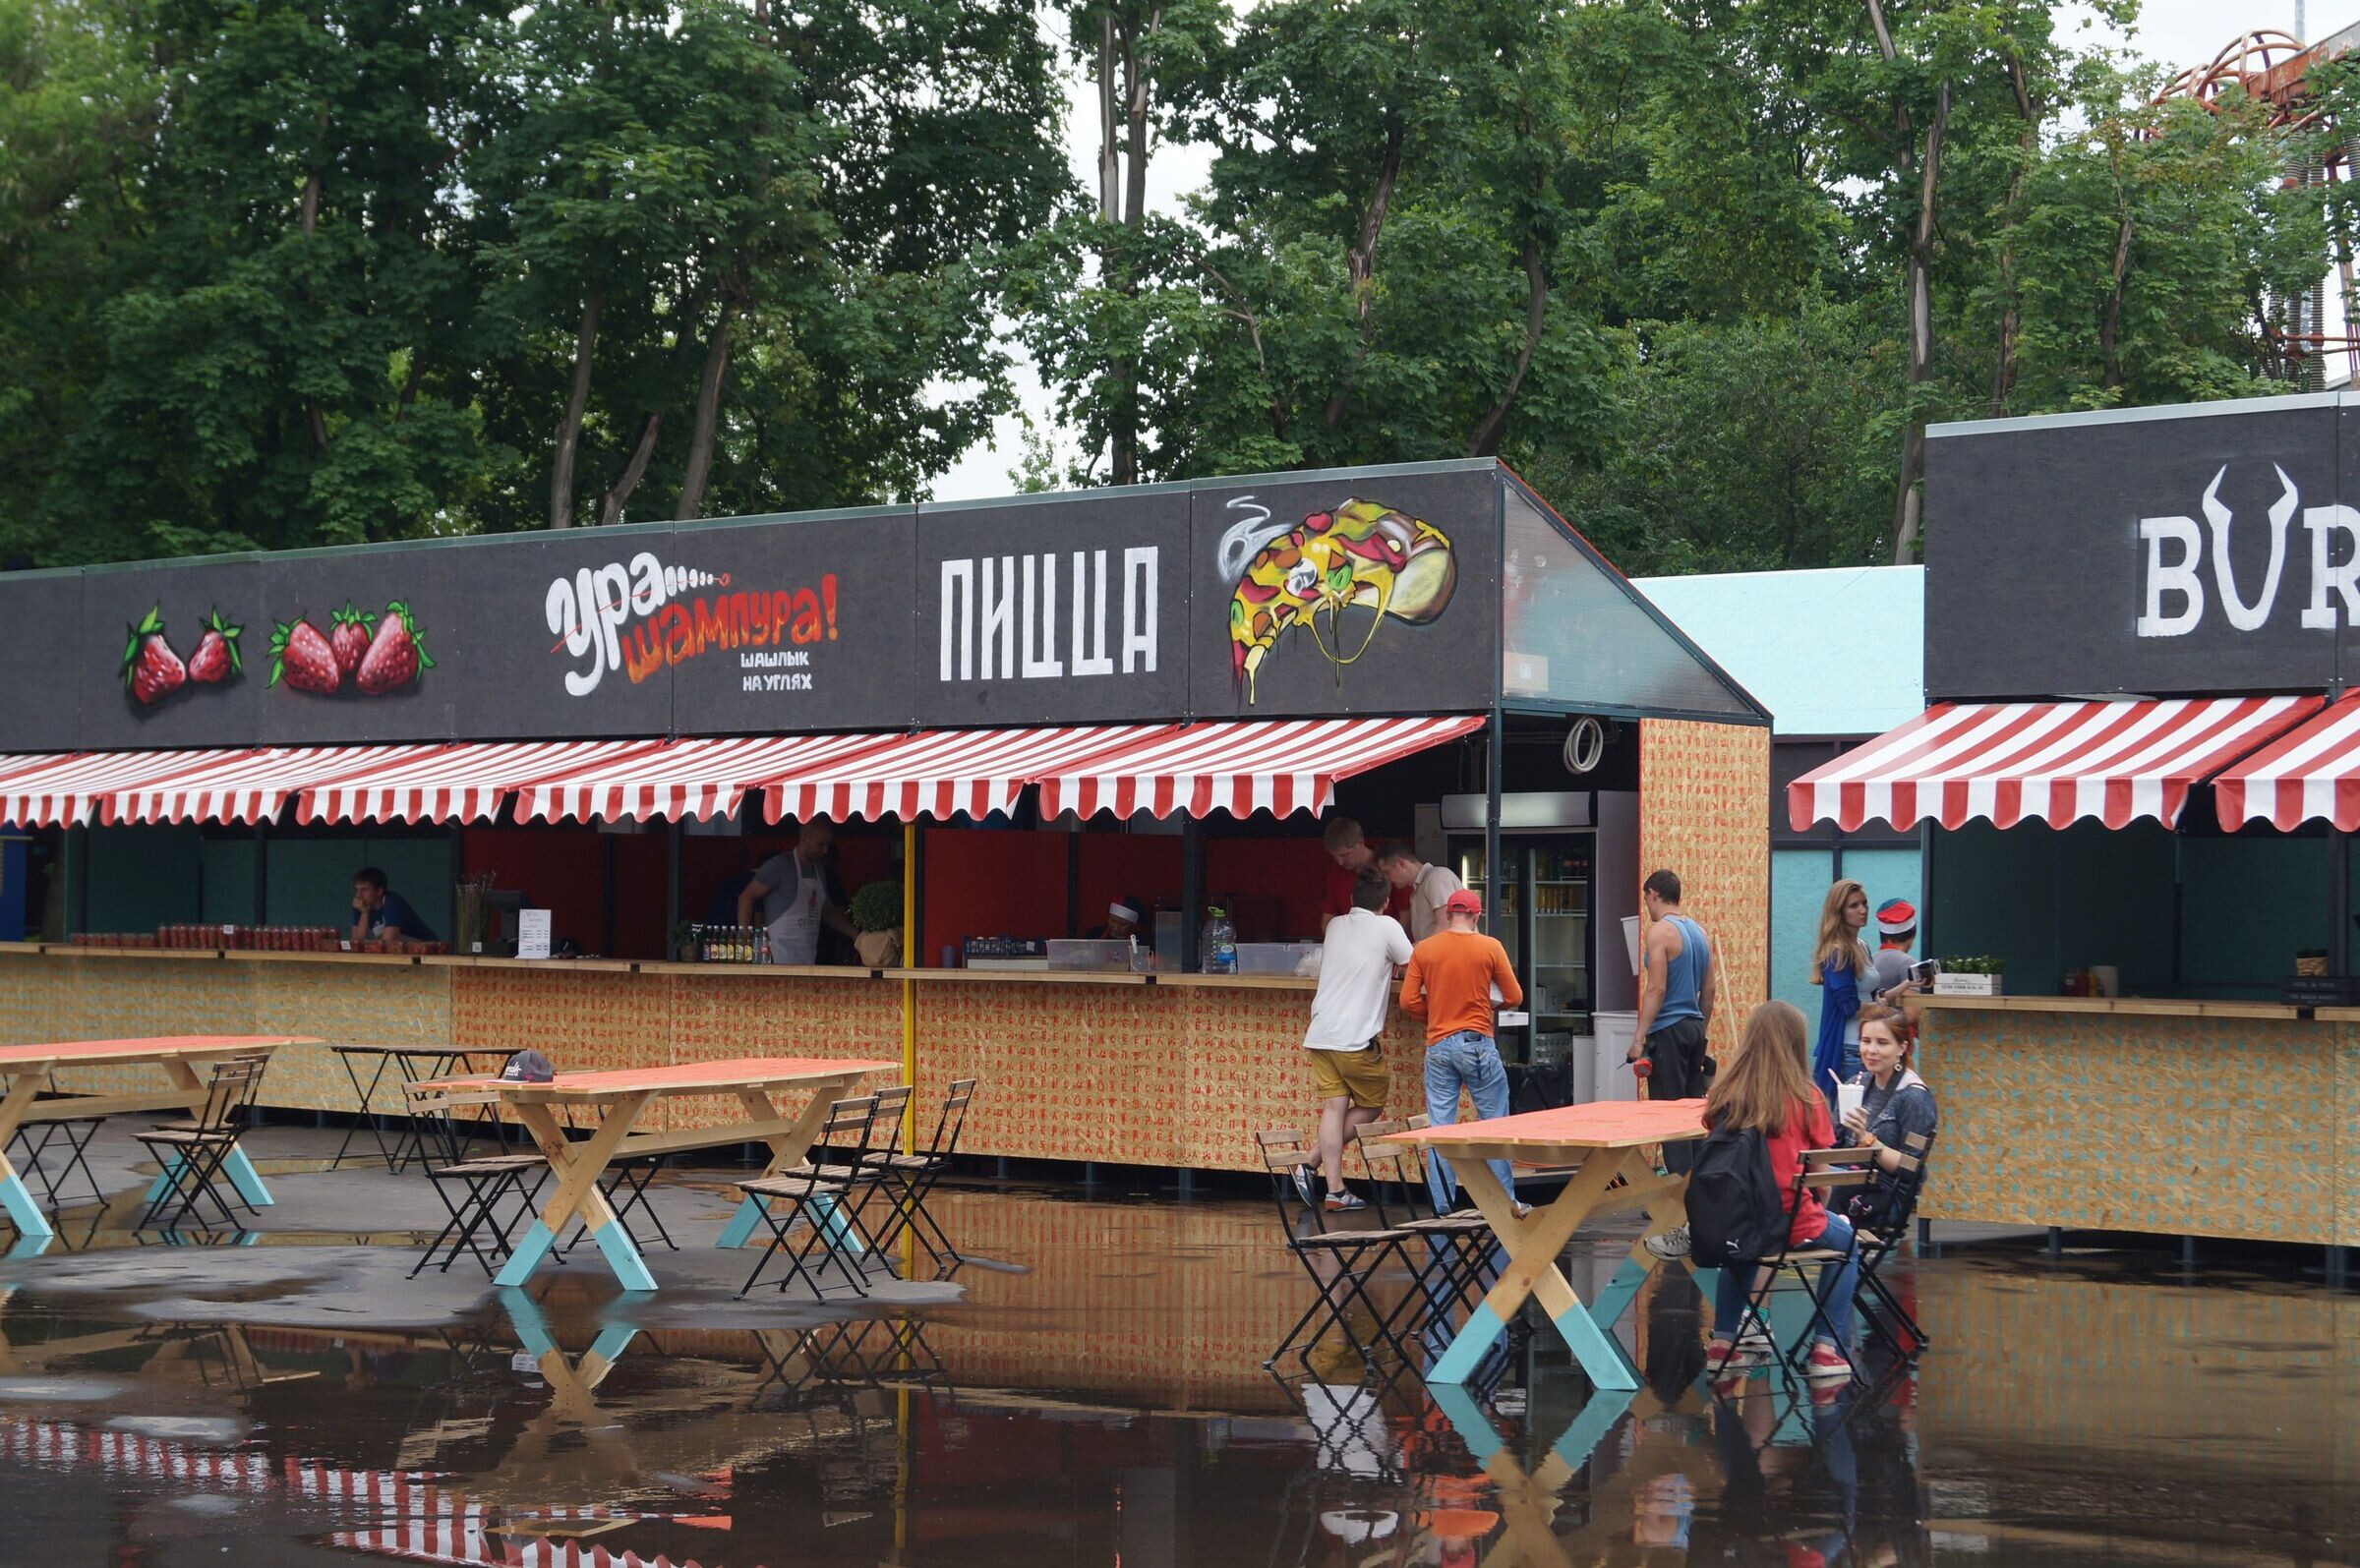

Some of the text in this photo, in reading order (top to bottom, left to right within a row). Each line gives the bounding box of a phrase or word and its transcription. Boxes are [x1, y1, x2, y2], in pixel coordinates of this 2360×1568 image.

[940, 546, 1158, 682] ПИЦЦА
[739, 651, 809, 668] ШАШЛЫК
[742, 674, 813, 692] НА УГЛЯХ
